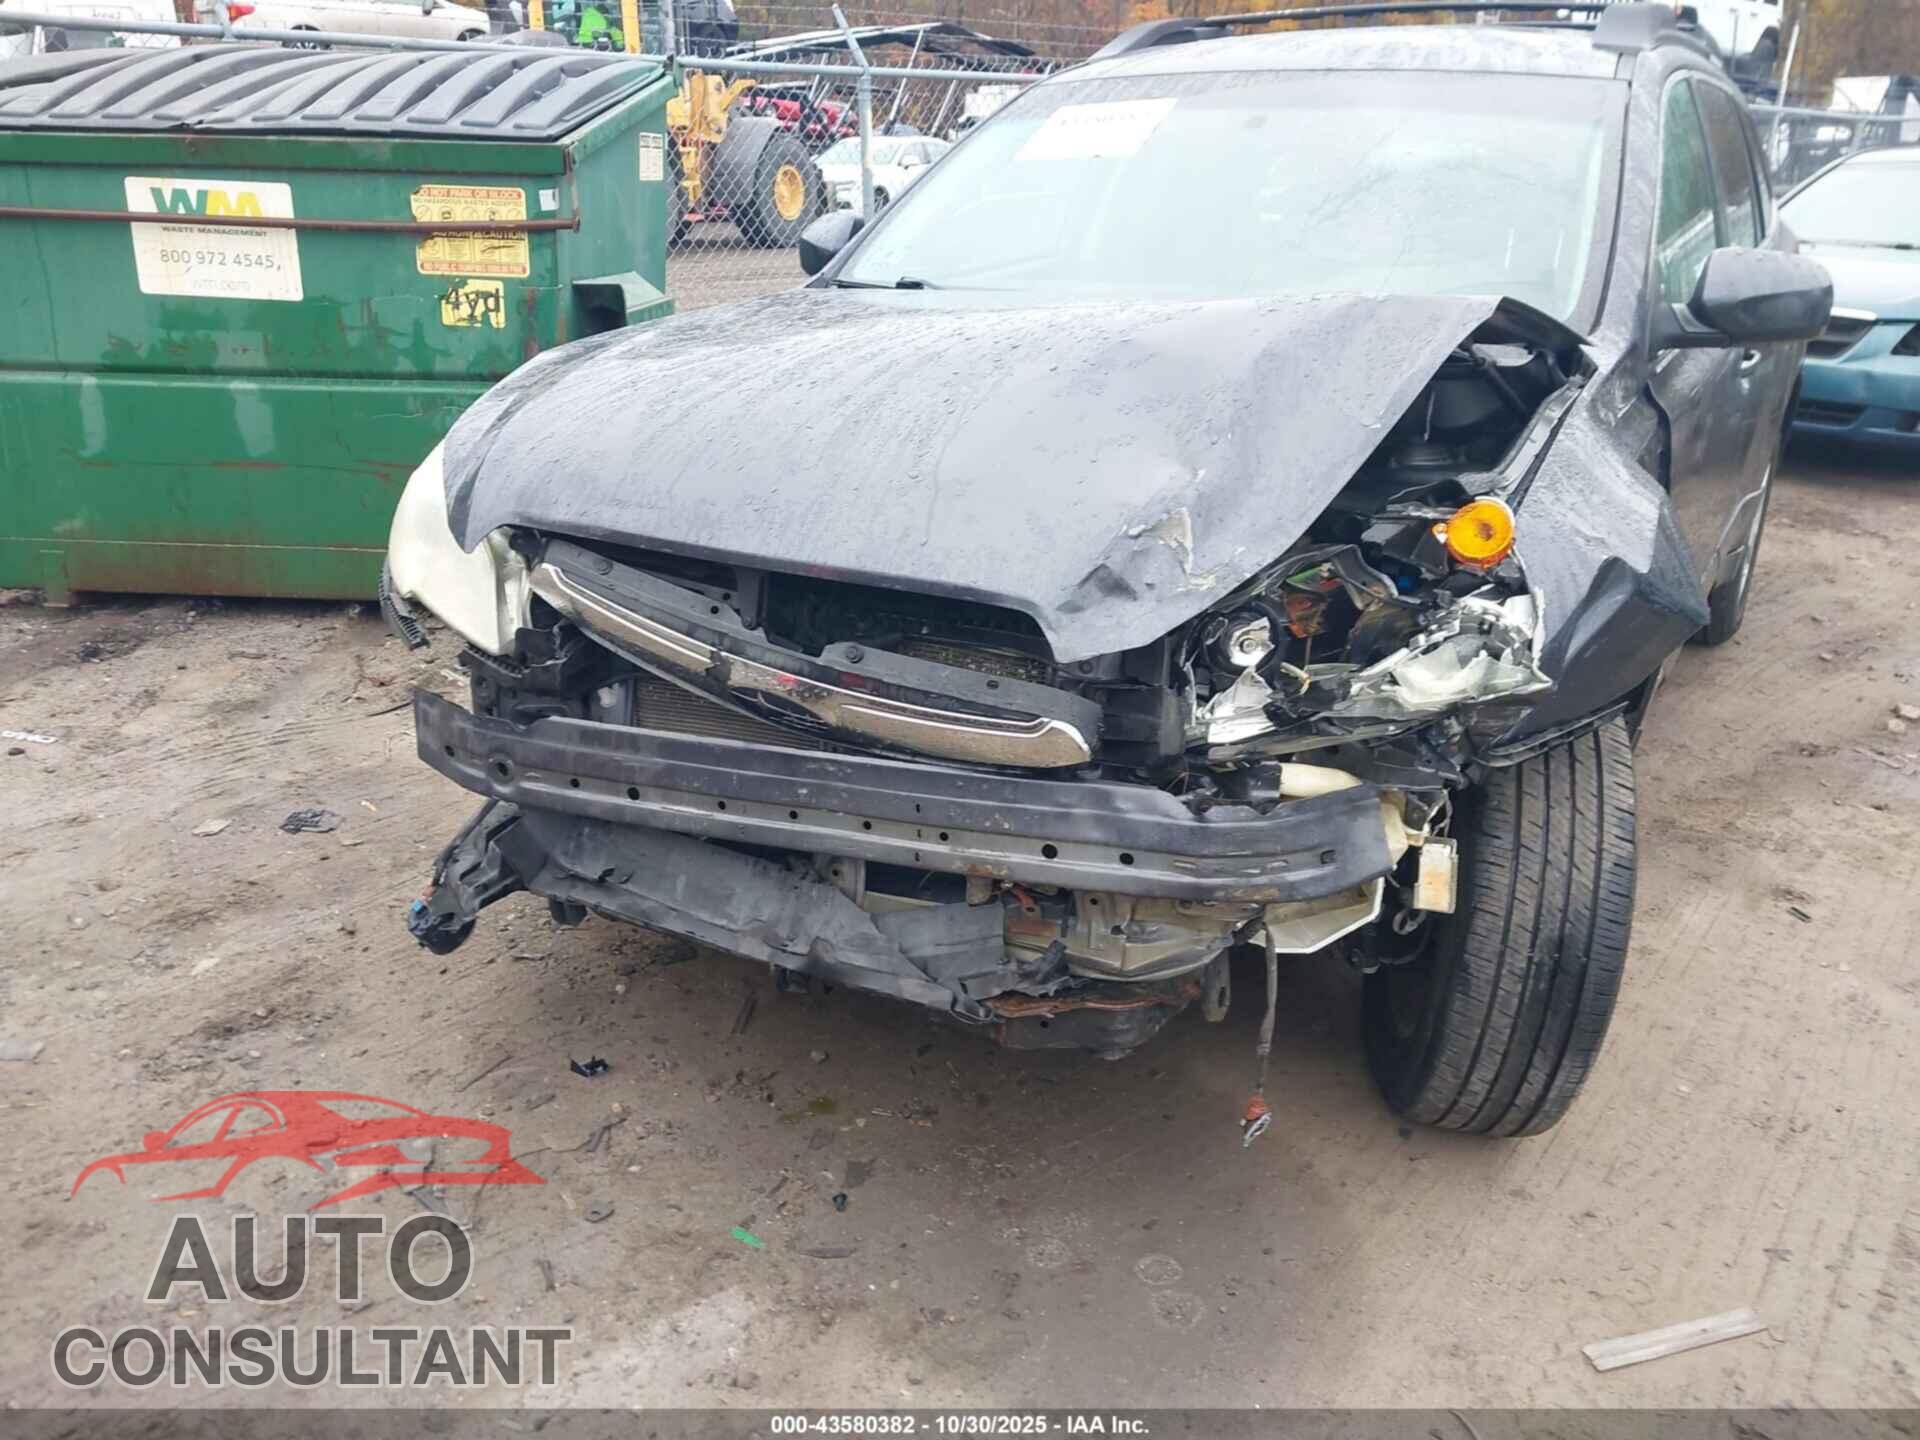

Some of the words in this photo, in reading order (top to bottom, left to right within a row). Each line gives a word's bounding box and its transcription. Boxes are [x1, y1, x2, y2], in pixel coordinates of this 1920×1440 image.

[150, 186, 263, 218] WM
[161, 225, 194, 234] WASTE
[197, 227, 268, 238] MANAGEMENT
[160, 249, 191, 264] 800
[195, 251, 228, 267] 972
